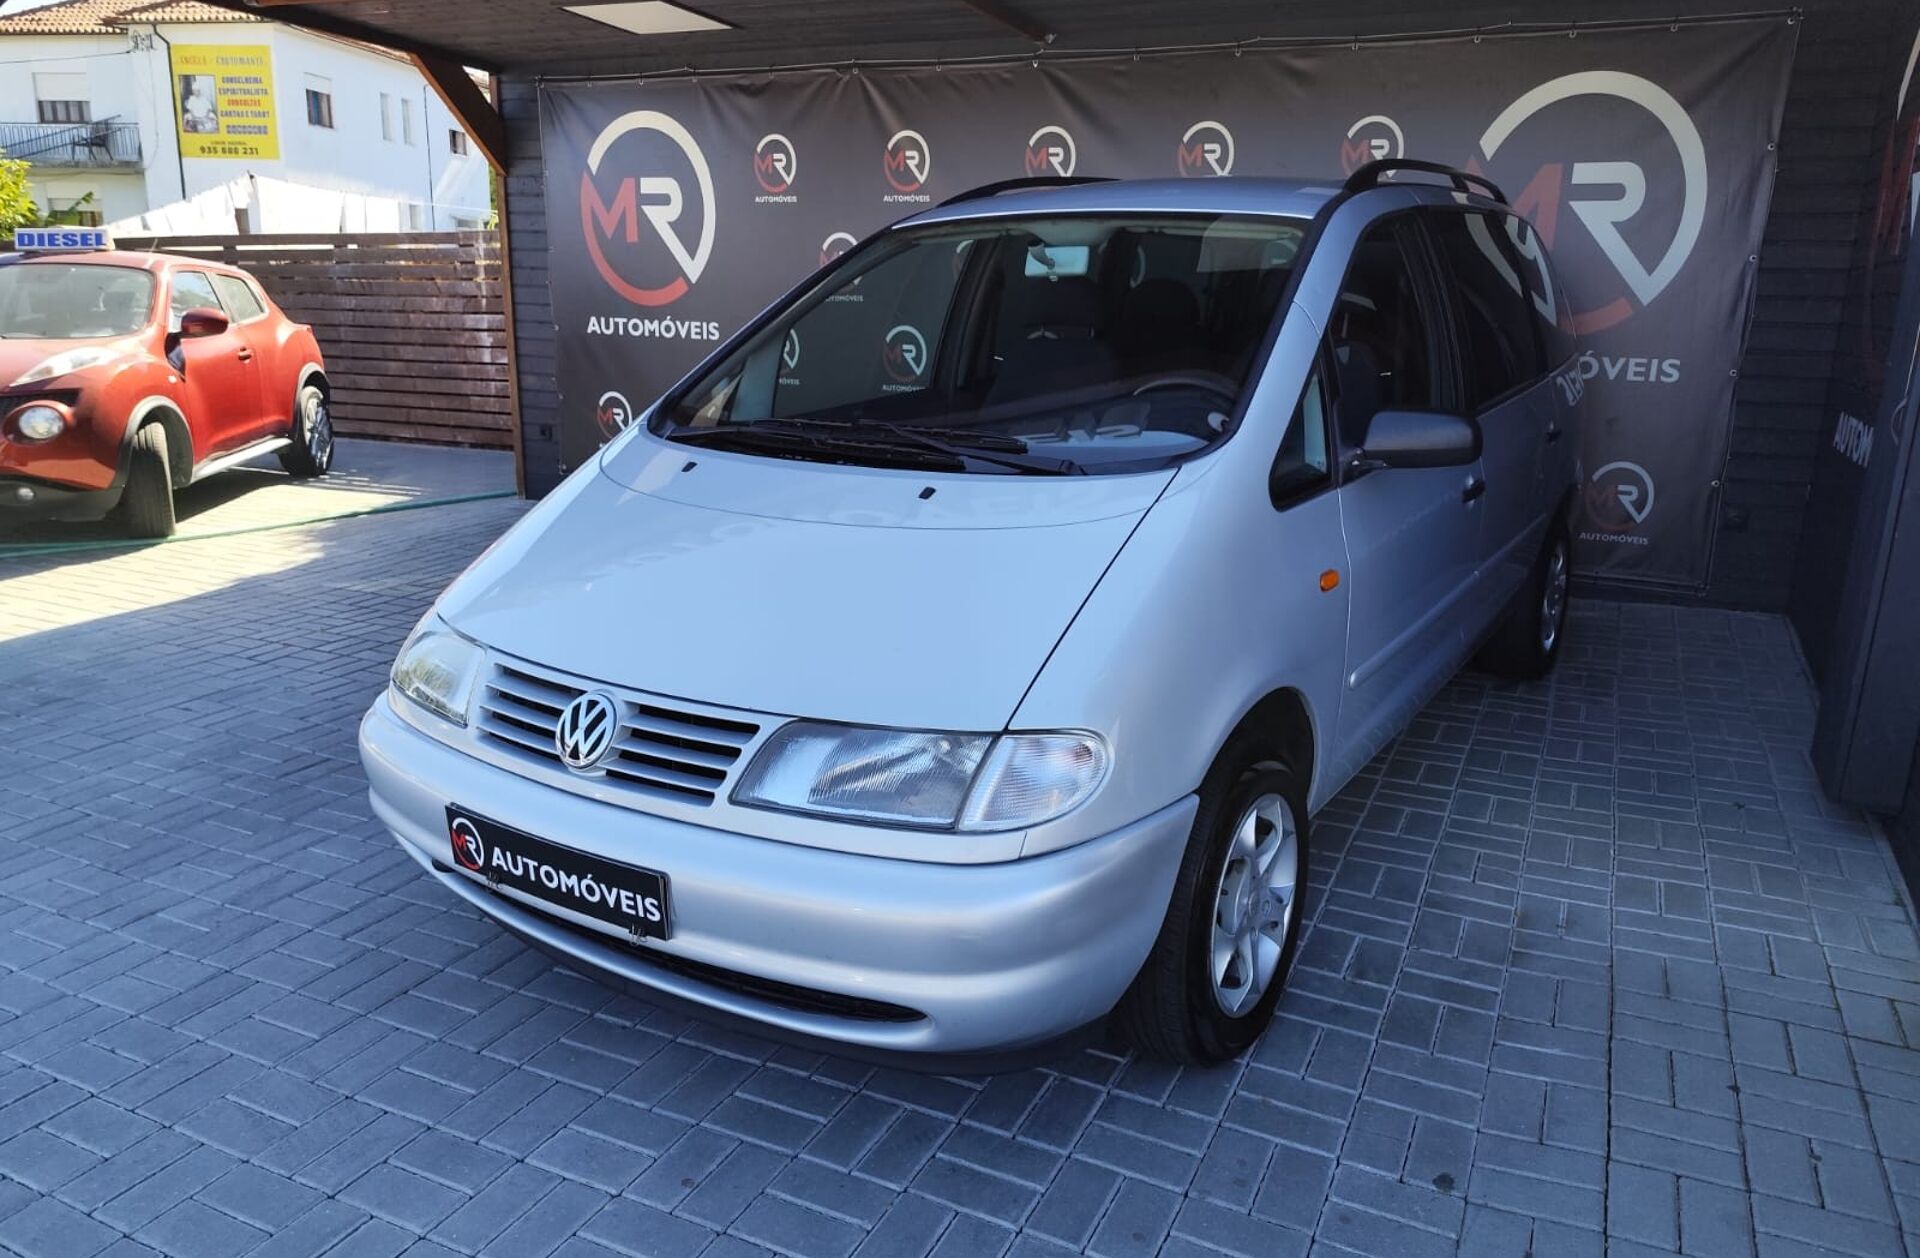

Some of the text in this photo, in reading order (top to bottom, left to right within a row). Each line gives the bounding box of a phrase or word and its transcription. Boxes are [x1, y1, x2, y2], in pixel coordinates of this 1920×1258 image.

[17, 233, 107, 247] DIESEL
[586, 316, 720, 341] AUTOMÓVEIS
[1579, 531, 1649, 546] AUTOMÓVEIS
[491, 847, 662, 922] AUTOMÓVEIS
